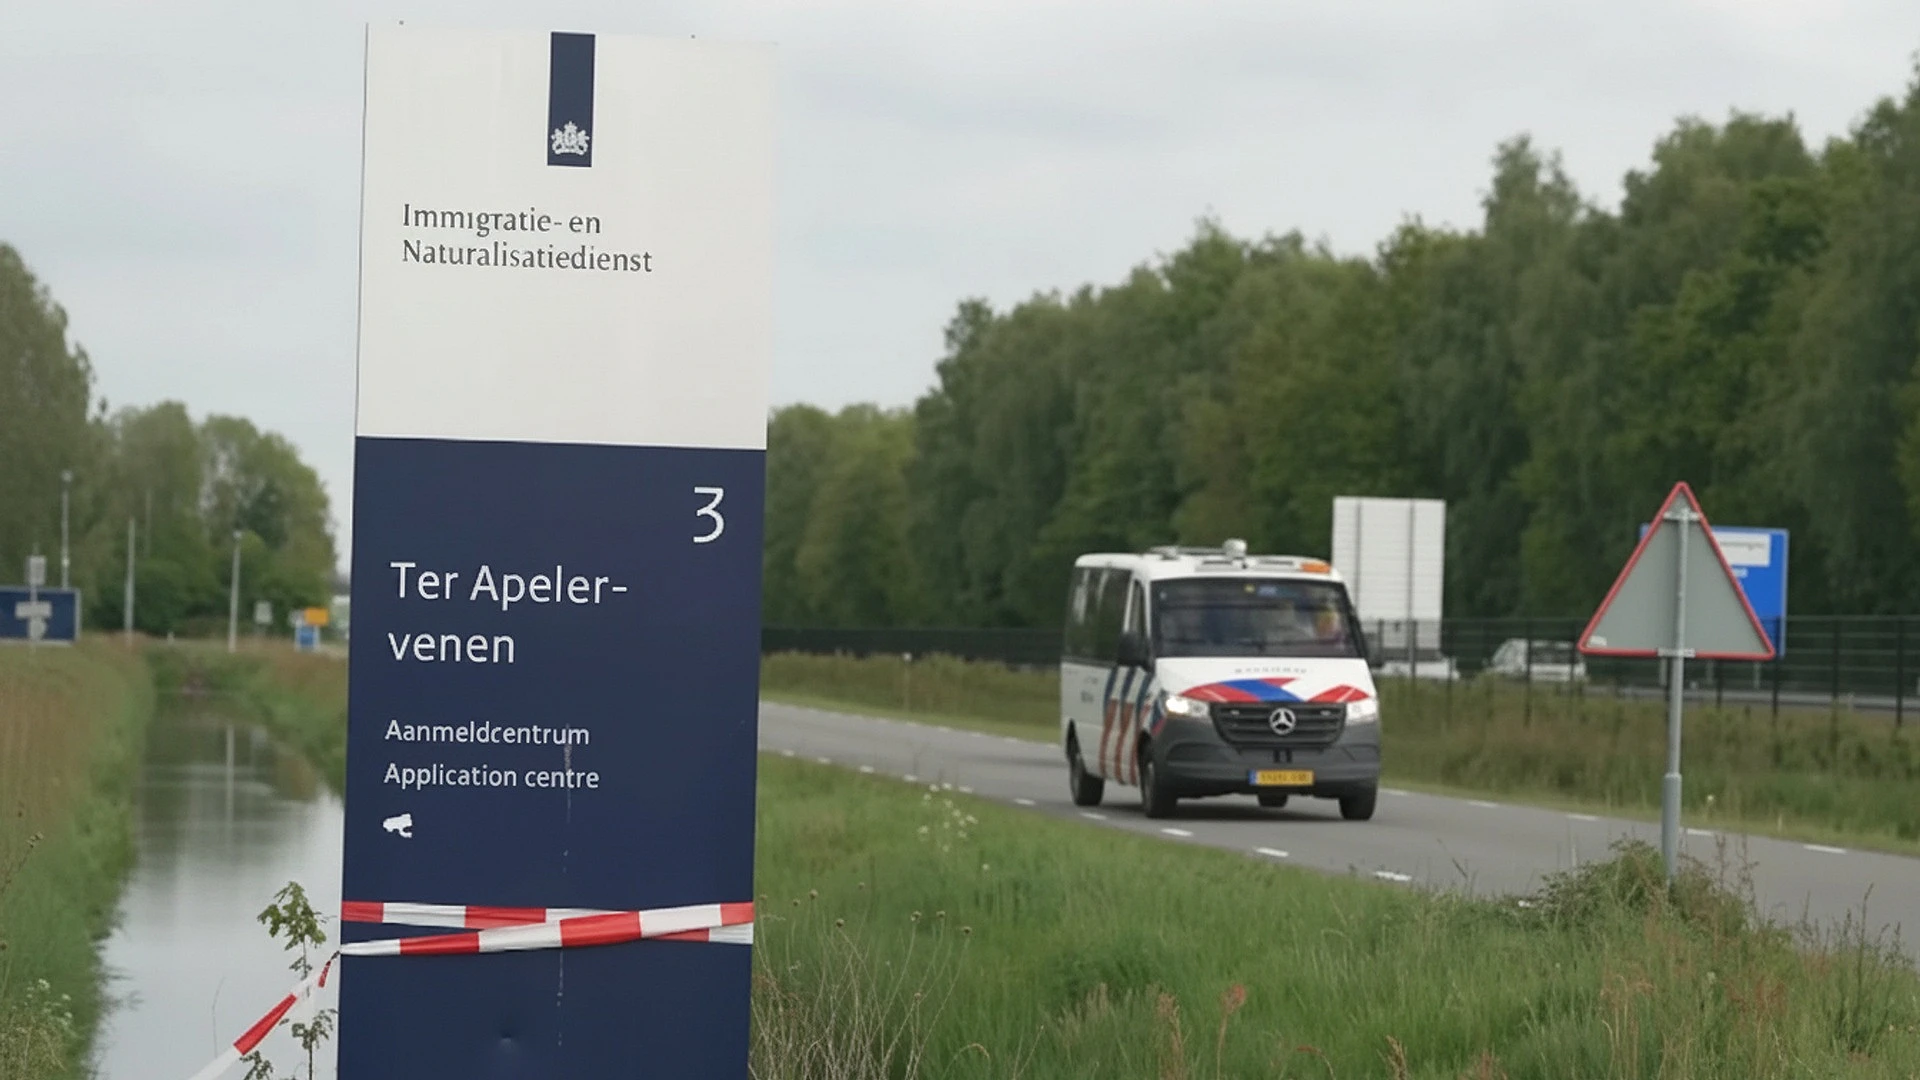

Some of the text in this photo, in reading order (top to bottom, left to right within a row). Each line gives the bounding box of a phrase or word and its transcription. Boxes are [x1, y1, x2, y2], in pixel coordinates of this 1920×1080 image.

[403, 203, 601, 237] Immigratie- en
[402, 239, 652, 273] Naturalisatiedienst
[693, 486, 725, 543] 3
[390, 561, 628, 611] Ter Apeler-
[388, 632, 515, 663] venen
[385, 719, 590, 745] Aanmeldcentrum
[383, 762, 600, 790] Application centre
